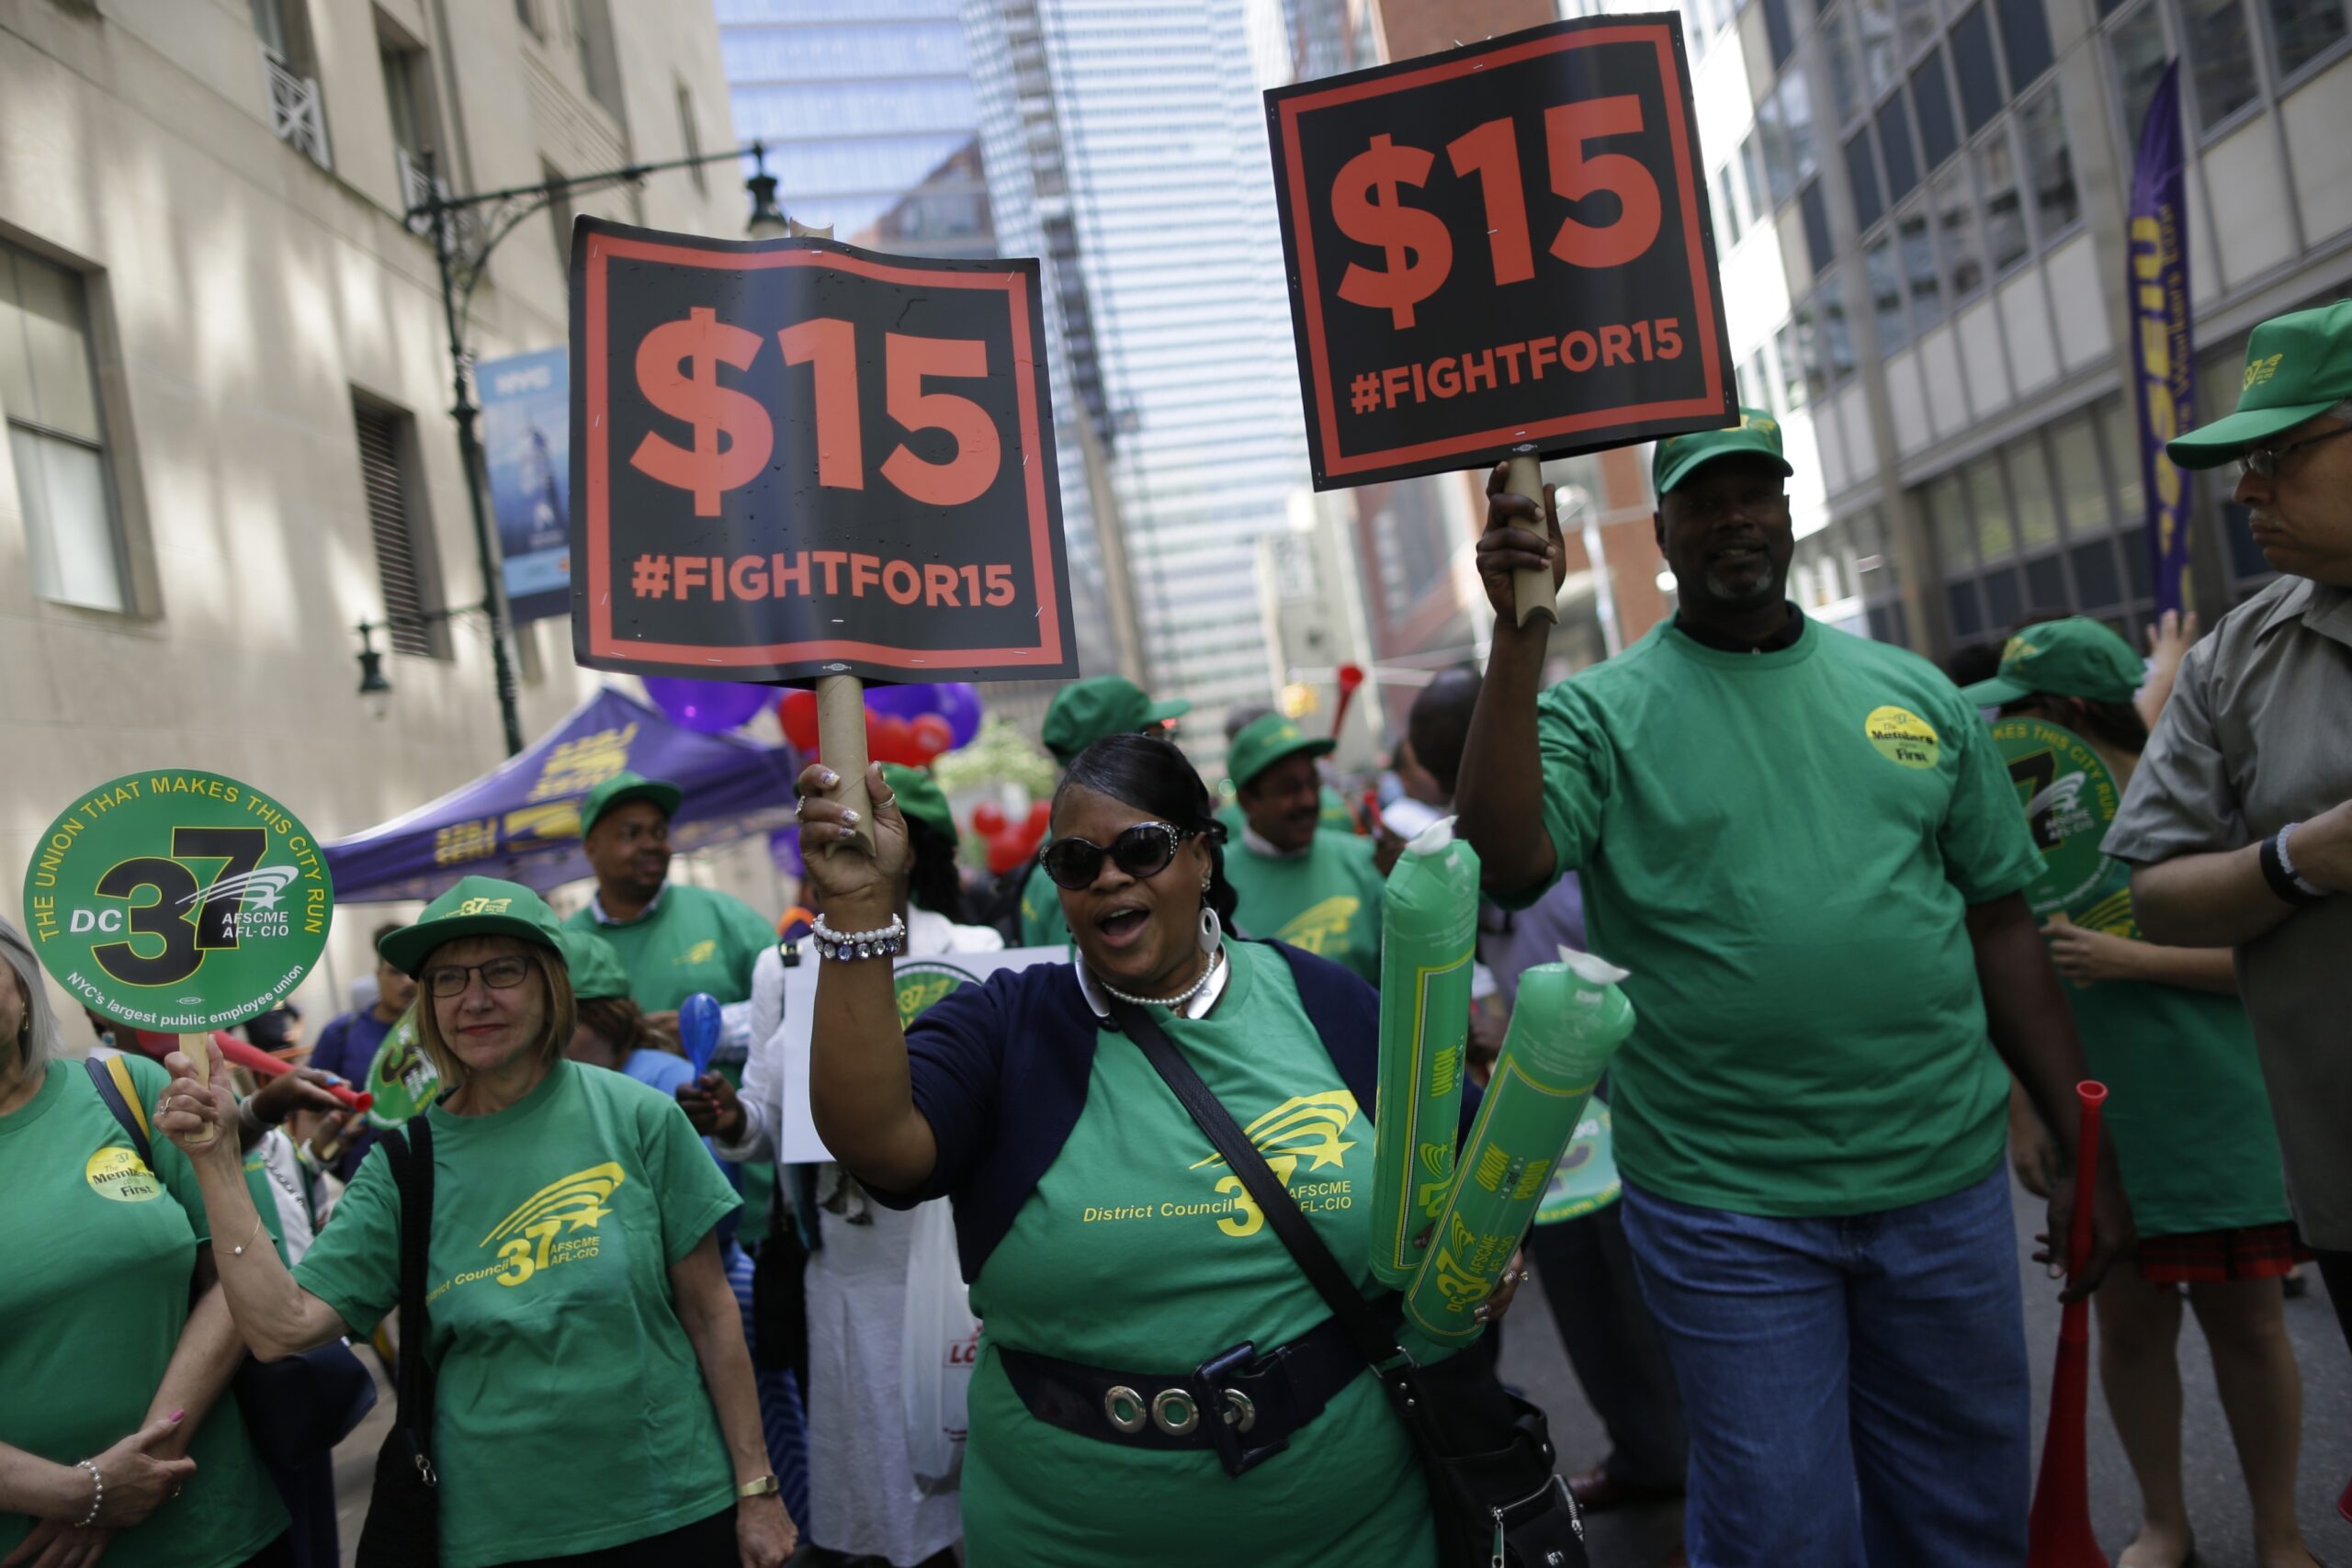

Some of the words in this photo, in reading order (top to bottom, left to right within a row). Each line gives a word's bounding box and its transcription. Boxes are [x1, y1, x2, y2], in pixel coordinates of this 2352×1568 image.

[1330, 94, 1662, 331] $15
[1351, 318, 1683, 414] #FIGHTFOR15
[629, 307, 1001, 516] $15
[632, 551, 1016, 608] #FIGHTFOR15
[1992, 722, 2028, 740] KES
[80, 781, 141, 819] THAT
[150, 777, 241, 804] MAKES
[2007, 748, 2064, 851] 7
[247, 795, 293, 835] THIS
[36, 817, 86, 888] UNION
[288, 836, 322, 882] CITY
[34, 895, 60, 942] THE
[70, 908, 123, 933] DC
[91, 826, 268, 987] 37
[221, 911, 289, 925] AFSCME
[304, 887, 325, 934] RUN
[221, 925, 290, 939] AFL-CIO
[66, 971, 105, 1005] NYC's
[107, 998, 157, 1024] largest
[160, 1011, 207, 1027] public
[209, 991, 275, 1023] employee
[272, 964, 304, 995] union
[1475, 1142, 1510, 1192] UNION
[120, 1184, 153, 1197] First
[1083, 1205, 1153, 1222] District
[1160, 1199, 1234, 1217] Council
[1288, 1180, 1351, 1200] AFSCME
[1300, 1196, 1352, 1213] FL-CIO
[455, 1258, 511, 1285] Council
[496, 1220, 561, 1287] 37
[550, 1236, 600, 1254] AFSCME
[550, 1247, 599, 1266] AFL-CIO
